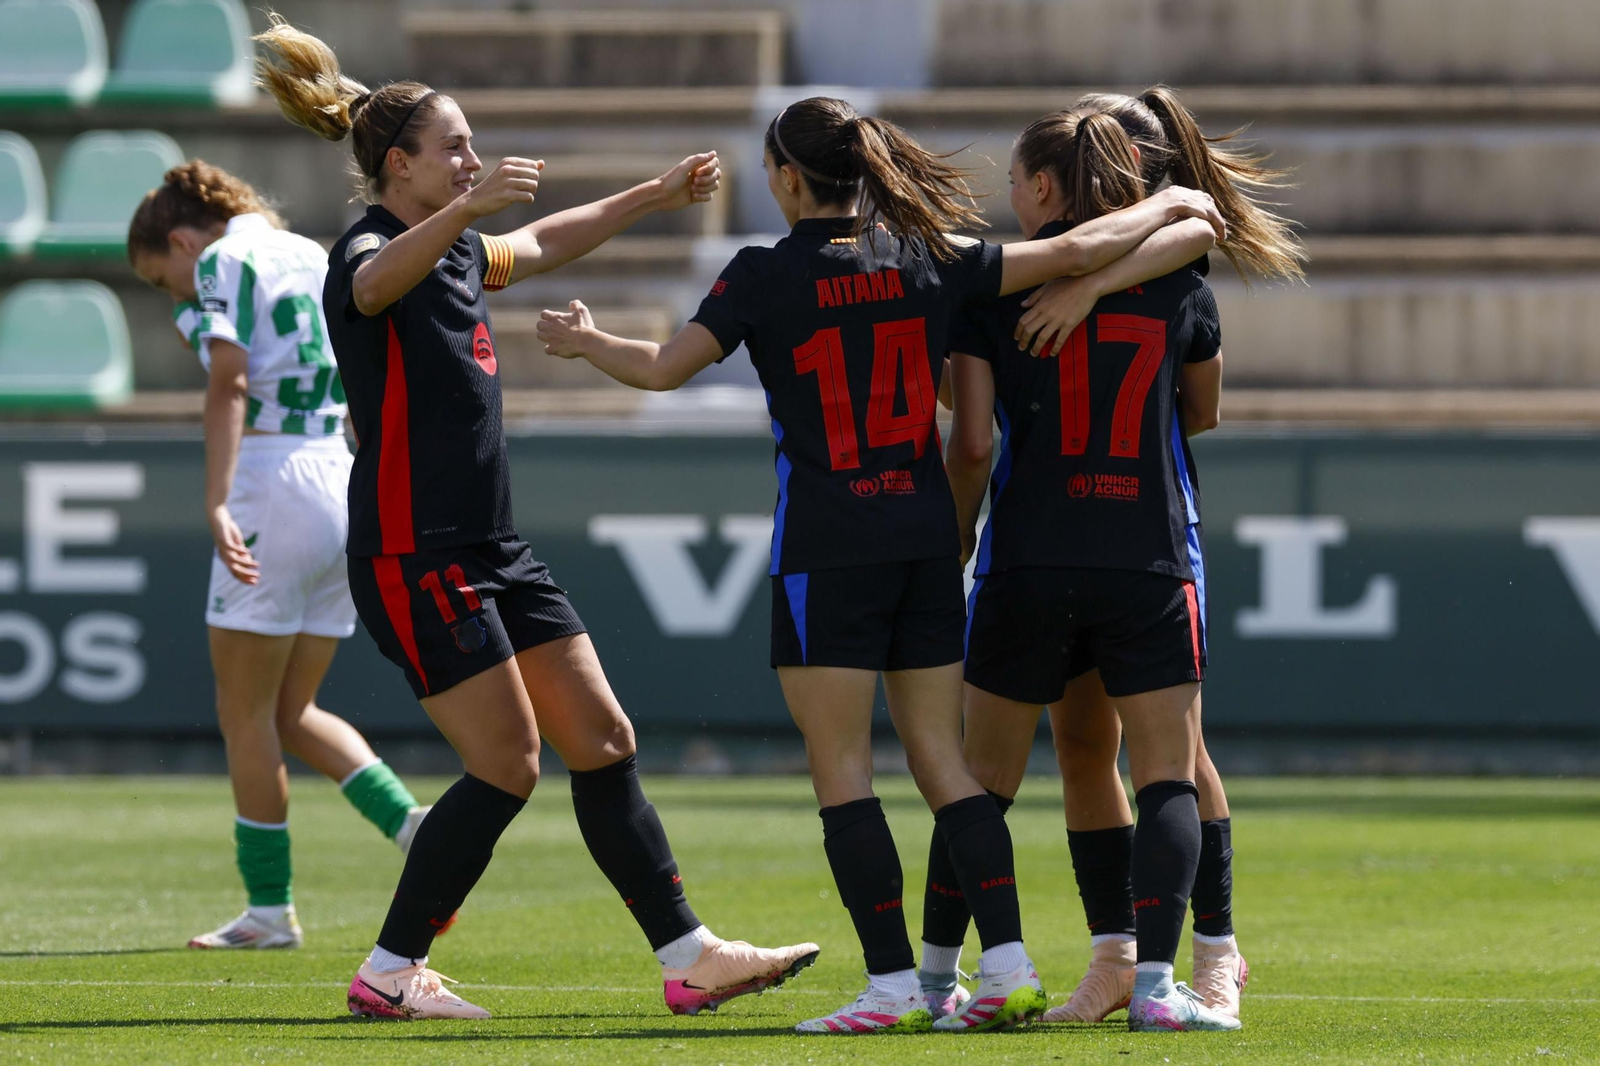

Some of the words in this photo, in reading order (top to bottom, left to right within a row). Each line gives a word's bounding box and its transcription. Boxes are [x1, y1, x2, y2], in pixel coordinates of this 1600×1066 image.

[816, 269, 904, 308] AITANA
[272, 294, 346, 411] 3
[792, 317, 936, 470] 14
[1040, 314, 1167, 458] 17
[880, 470, 912, 481] UNCR
[1094, 474, 1139, 487] UNHCR
[1094, 484, 1139, 497] ACNUR
[418, 564, 481, 624] 11
